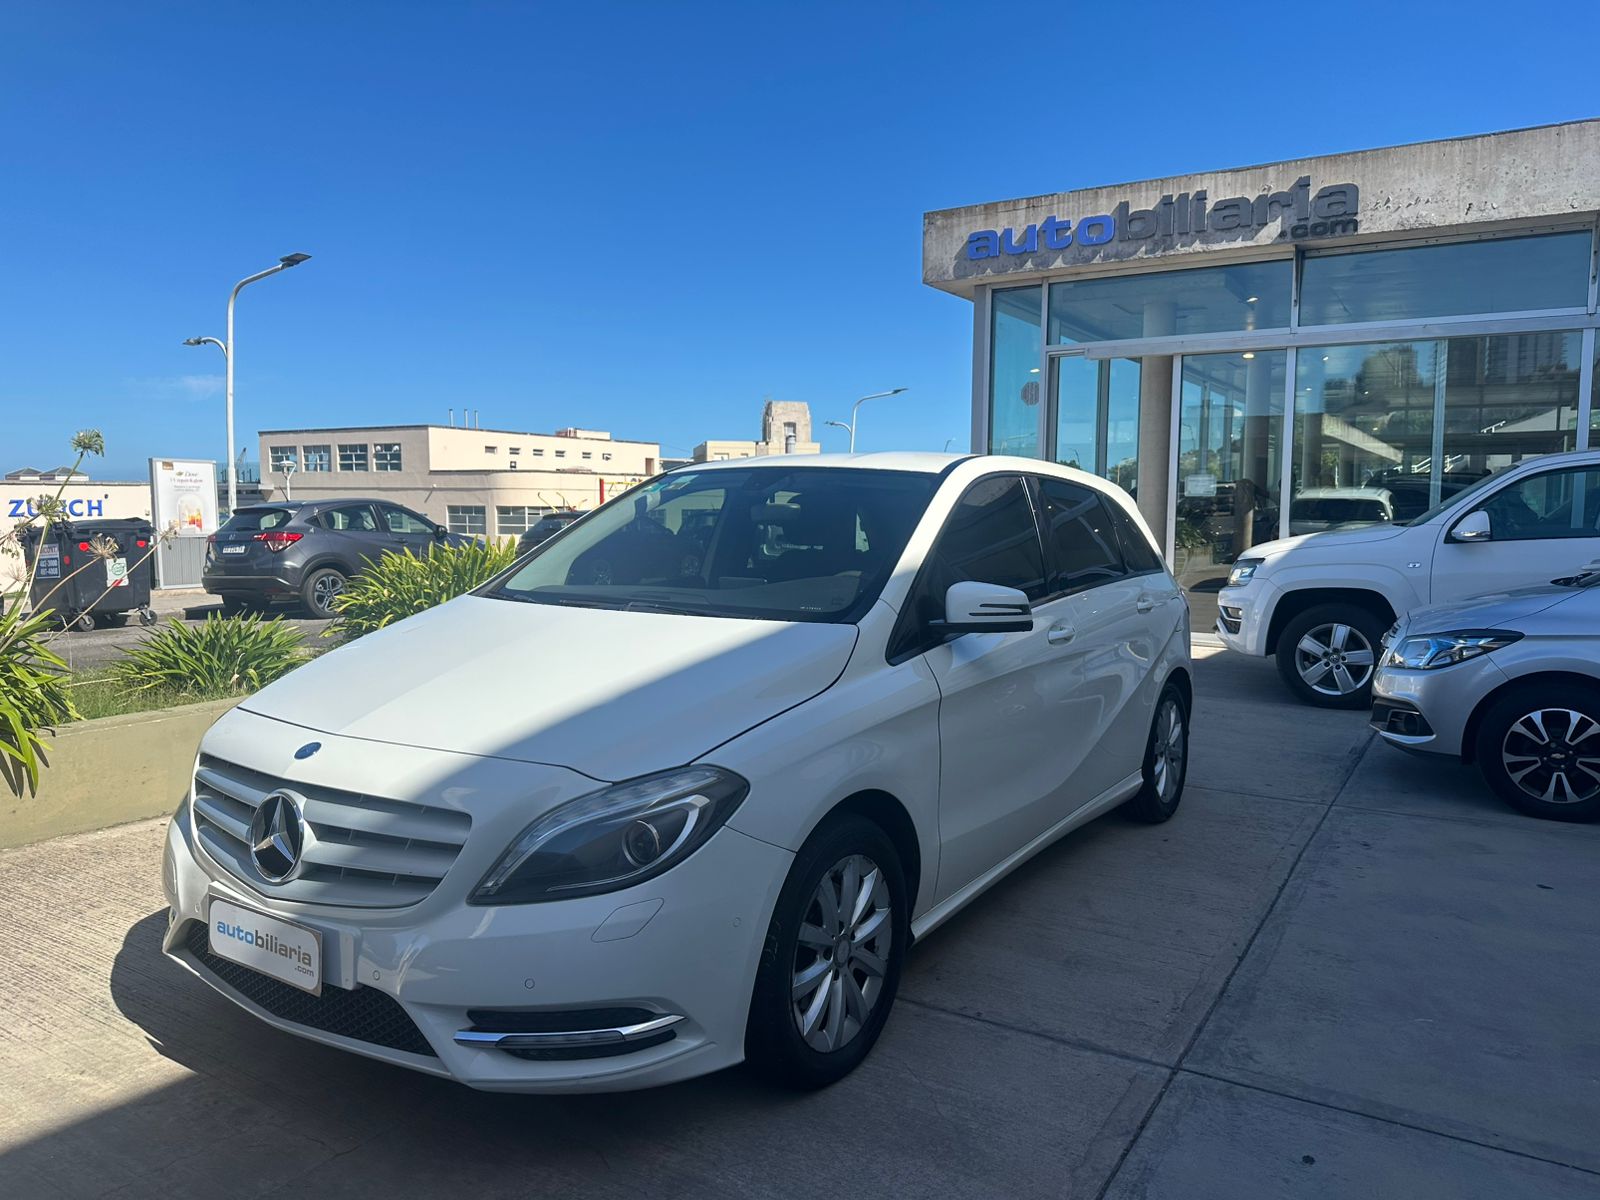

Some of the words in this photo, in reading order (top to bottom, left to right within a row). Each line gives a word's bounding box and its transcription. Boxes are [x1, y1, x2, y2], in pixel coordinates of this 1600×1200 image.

[967, 175, 1359, 260] autobiliaria
[1279, 218, 1358, 238] .com
[8, 499, 103, 518] ZUICH
[216, 921, 312, 967] autobiliaria
[294, 965, 315, 977] .com
